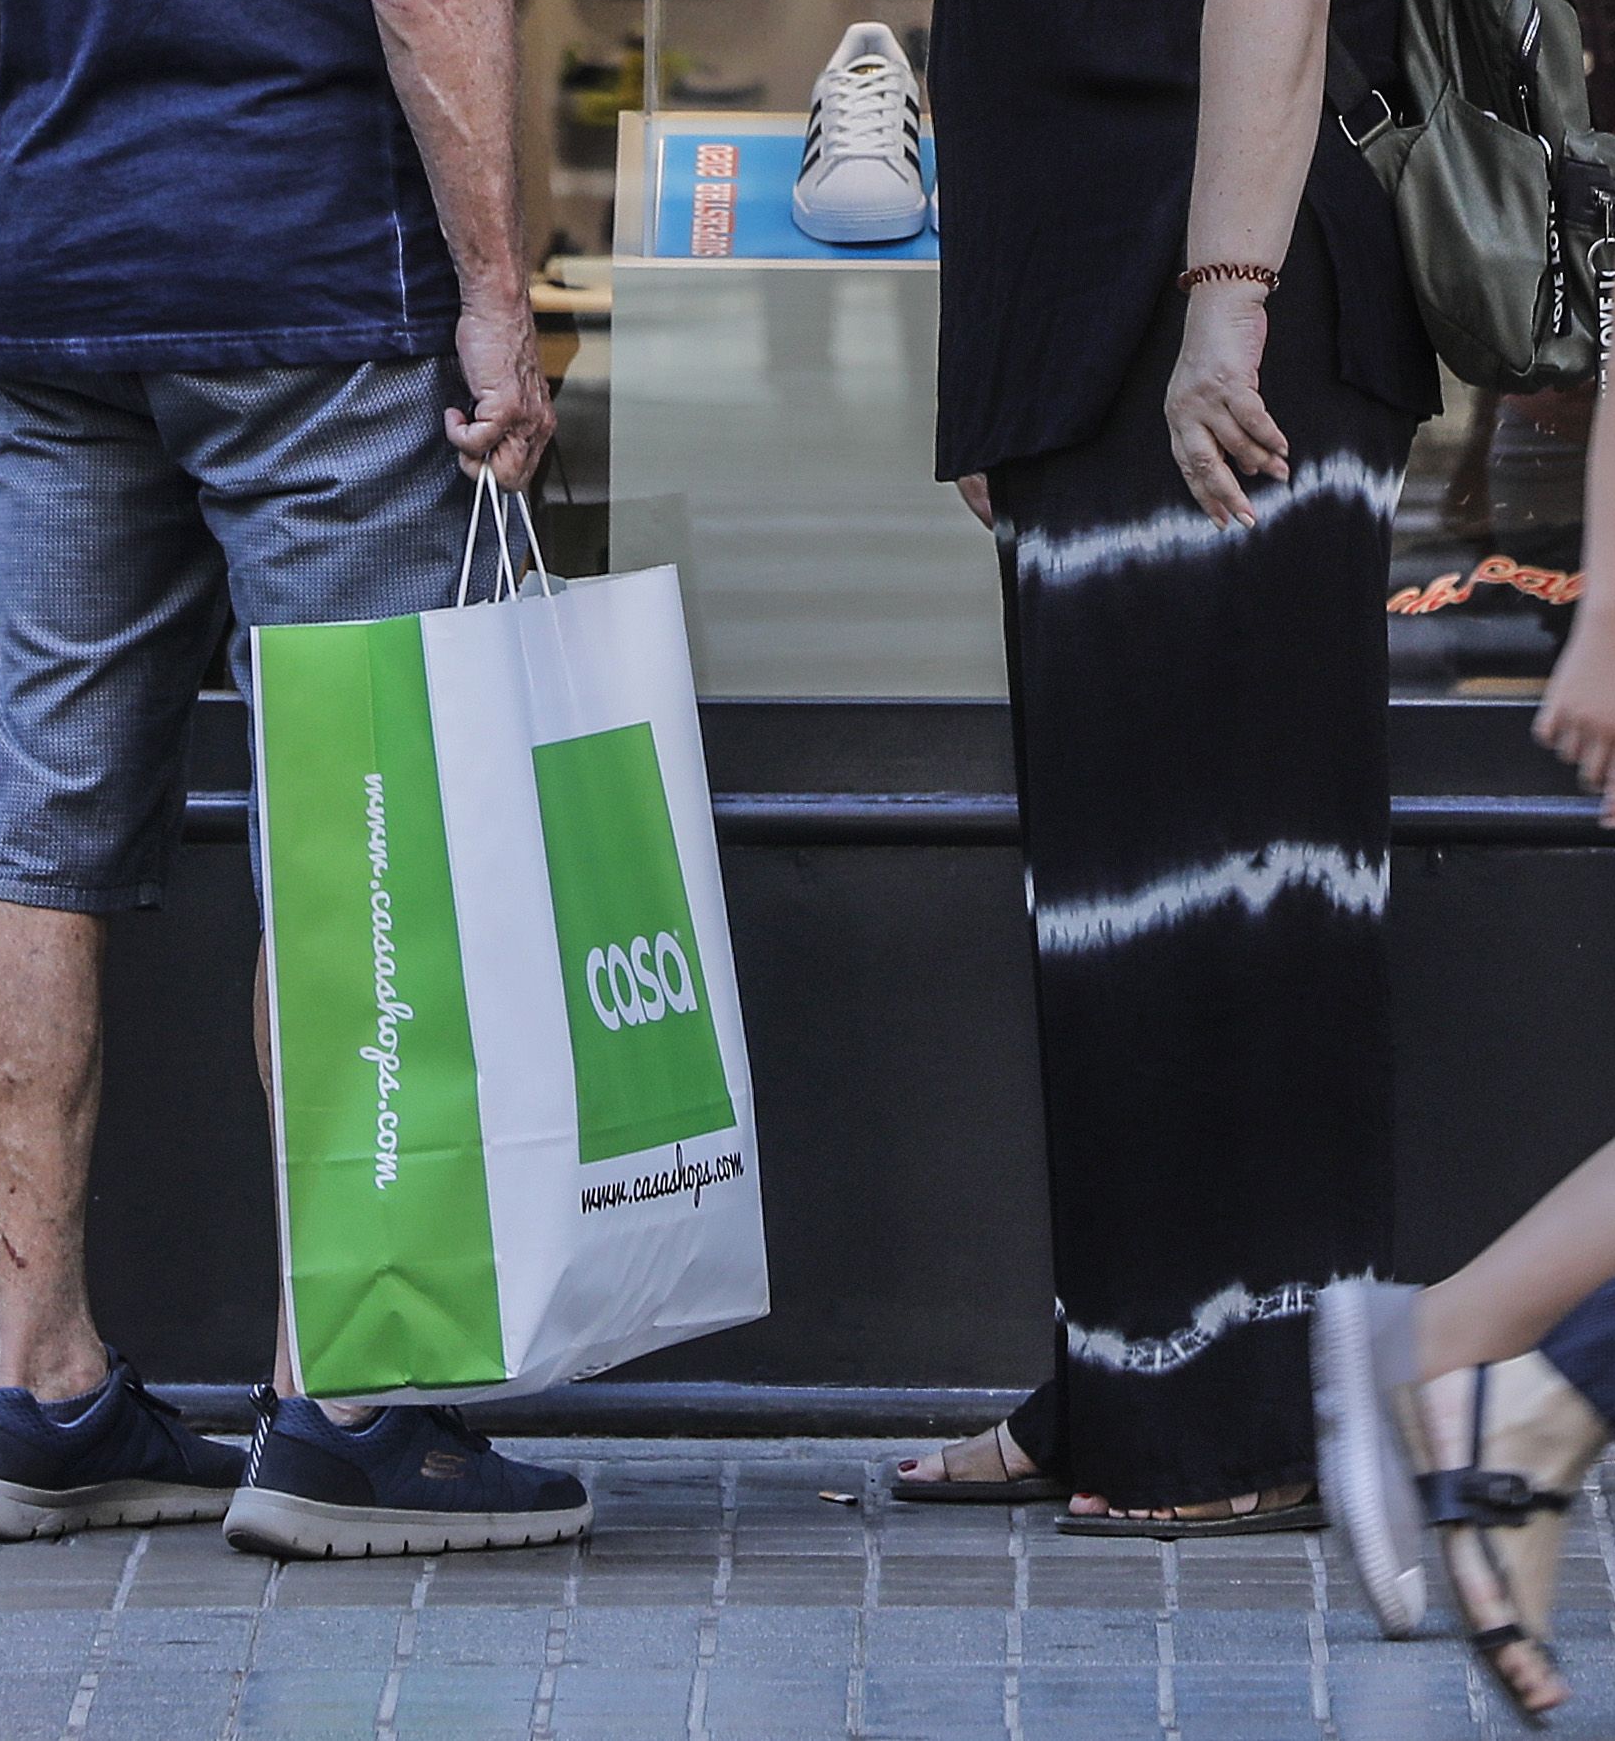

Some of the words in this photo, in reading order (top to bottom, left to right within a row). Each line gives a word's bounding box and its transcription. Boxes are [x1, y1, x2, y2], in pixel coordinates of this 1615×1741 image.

[1552, 271, 1565, 335] LOVE
[359, 772, 415, 1191] www.casashops.com
[586, 930, 698, 1032] casa
[580, 1141, 745, 1215] www.casashops.com
